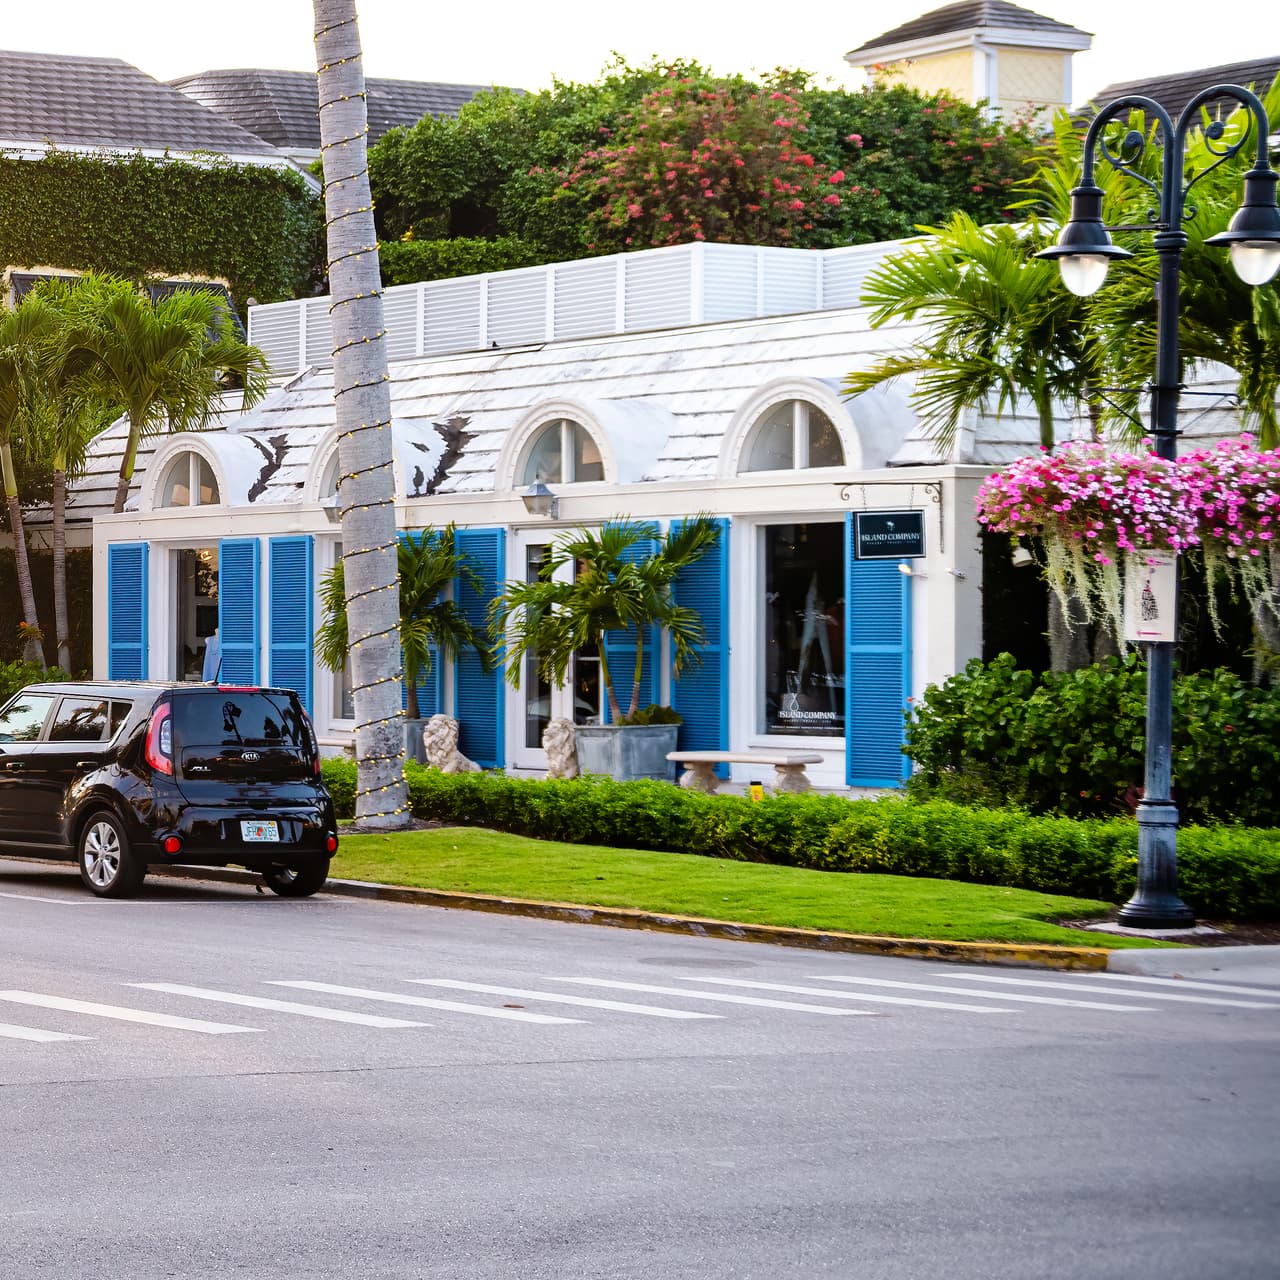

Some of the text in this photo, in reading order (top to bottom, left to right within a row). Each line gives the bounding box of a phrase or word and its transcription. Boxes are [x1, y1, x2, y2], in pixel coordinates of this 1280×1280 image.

[861, 532, 920, 541] ISLAND COMPANY
[779, 711, 835, 720] ISLAND COMPANY
